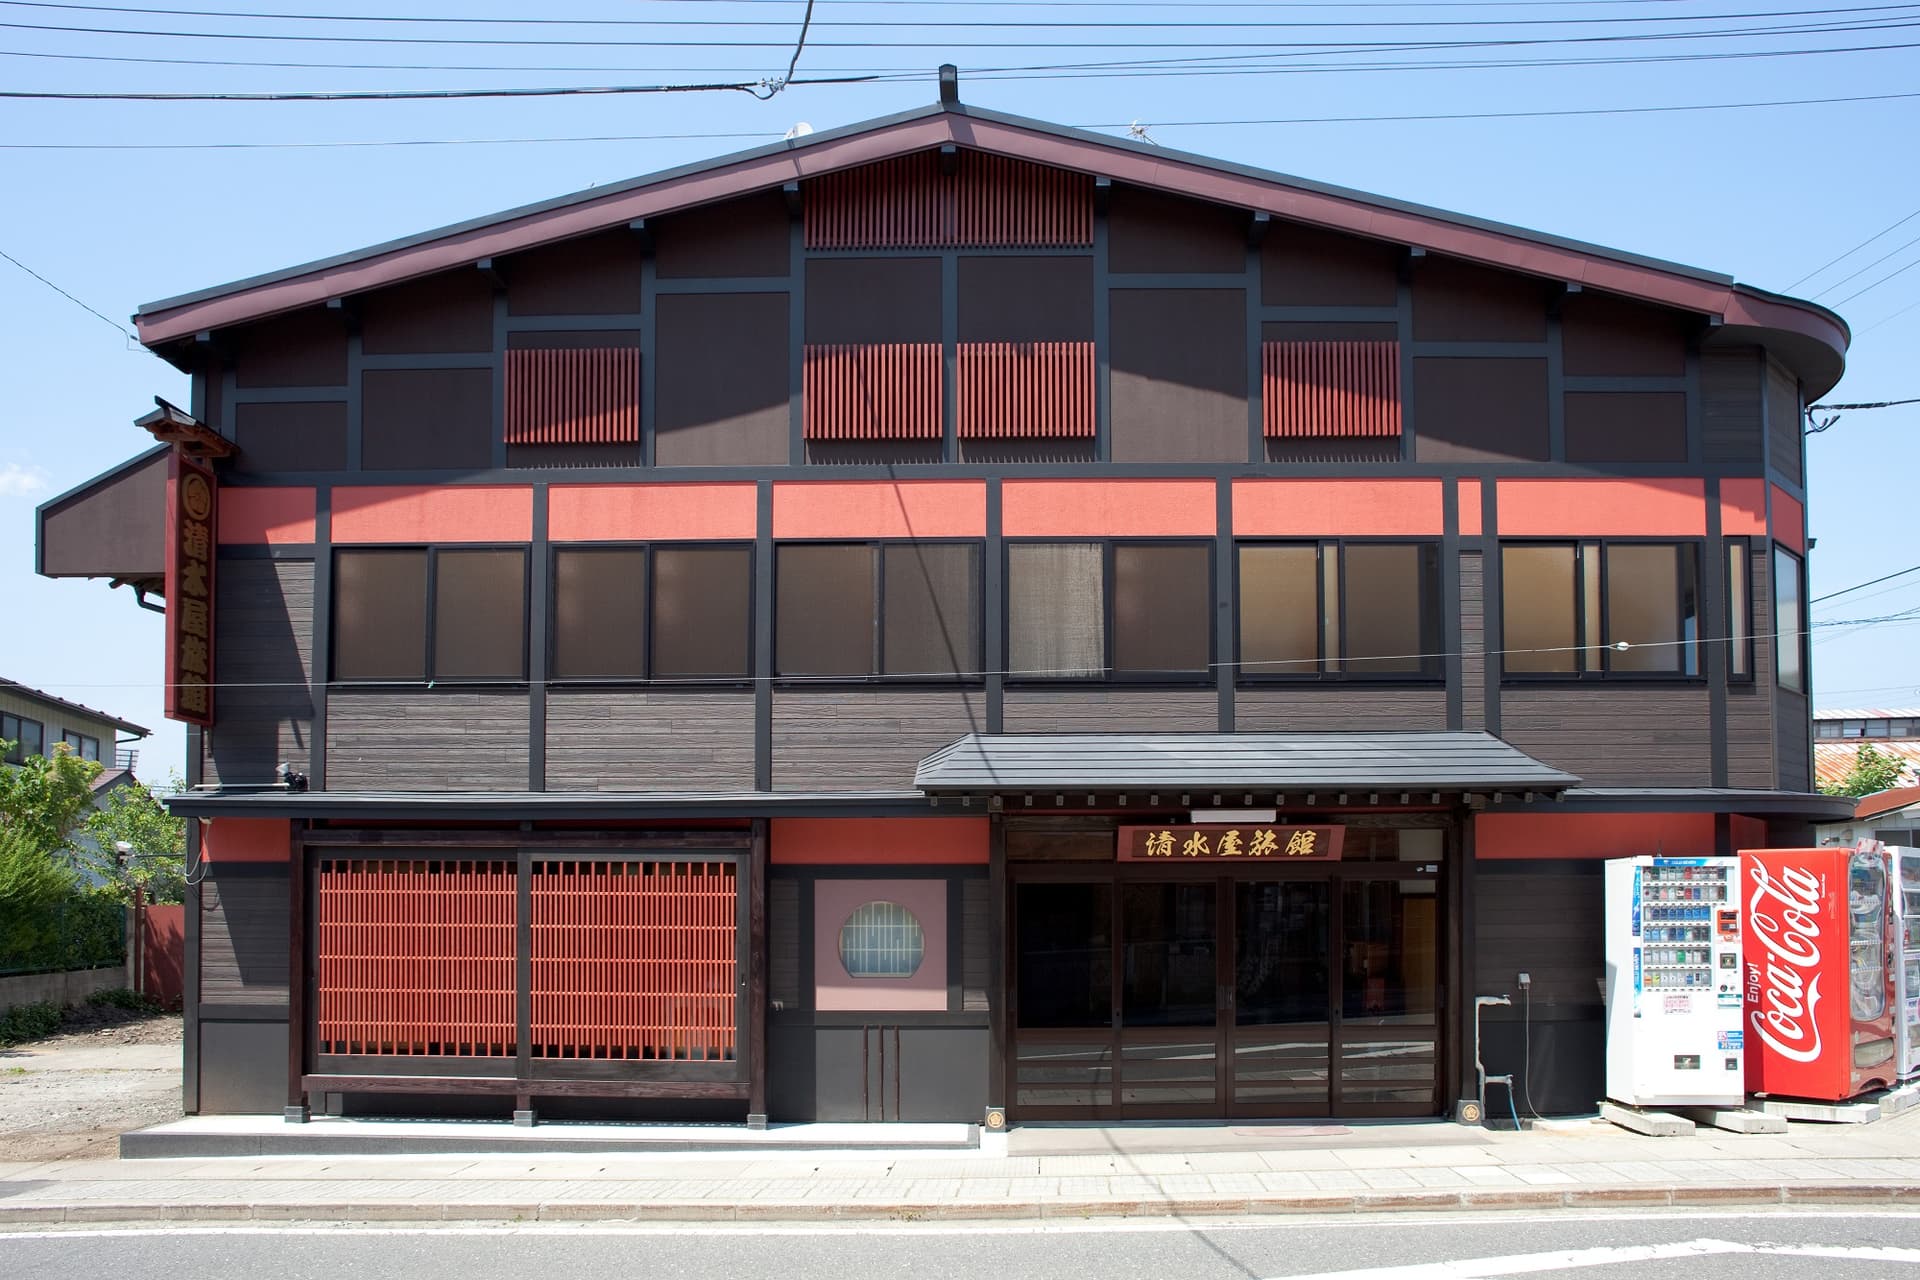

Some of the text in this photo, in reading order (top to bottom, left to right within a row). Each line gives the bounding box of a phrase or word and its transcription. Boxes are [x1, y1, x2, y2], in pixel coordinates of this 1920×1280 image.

[1145, 829, 1317, 857] 清水屋旅館
[1747, 963, 1761, 1003] Enjoy!
